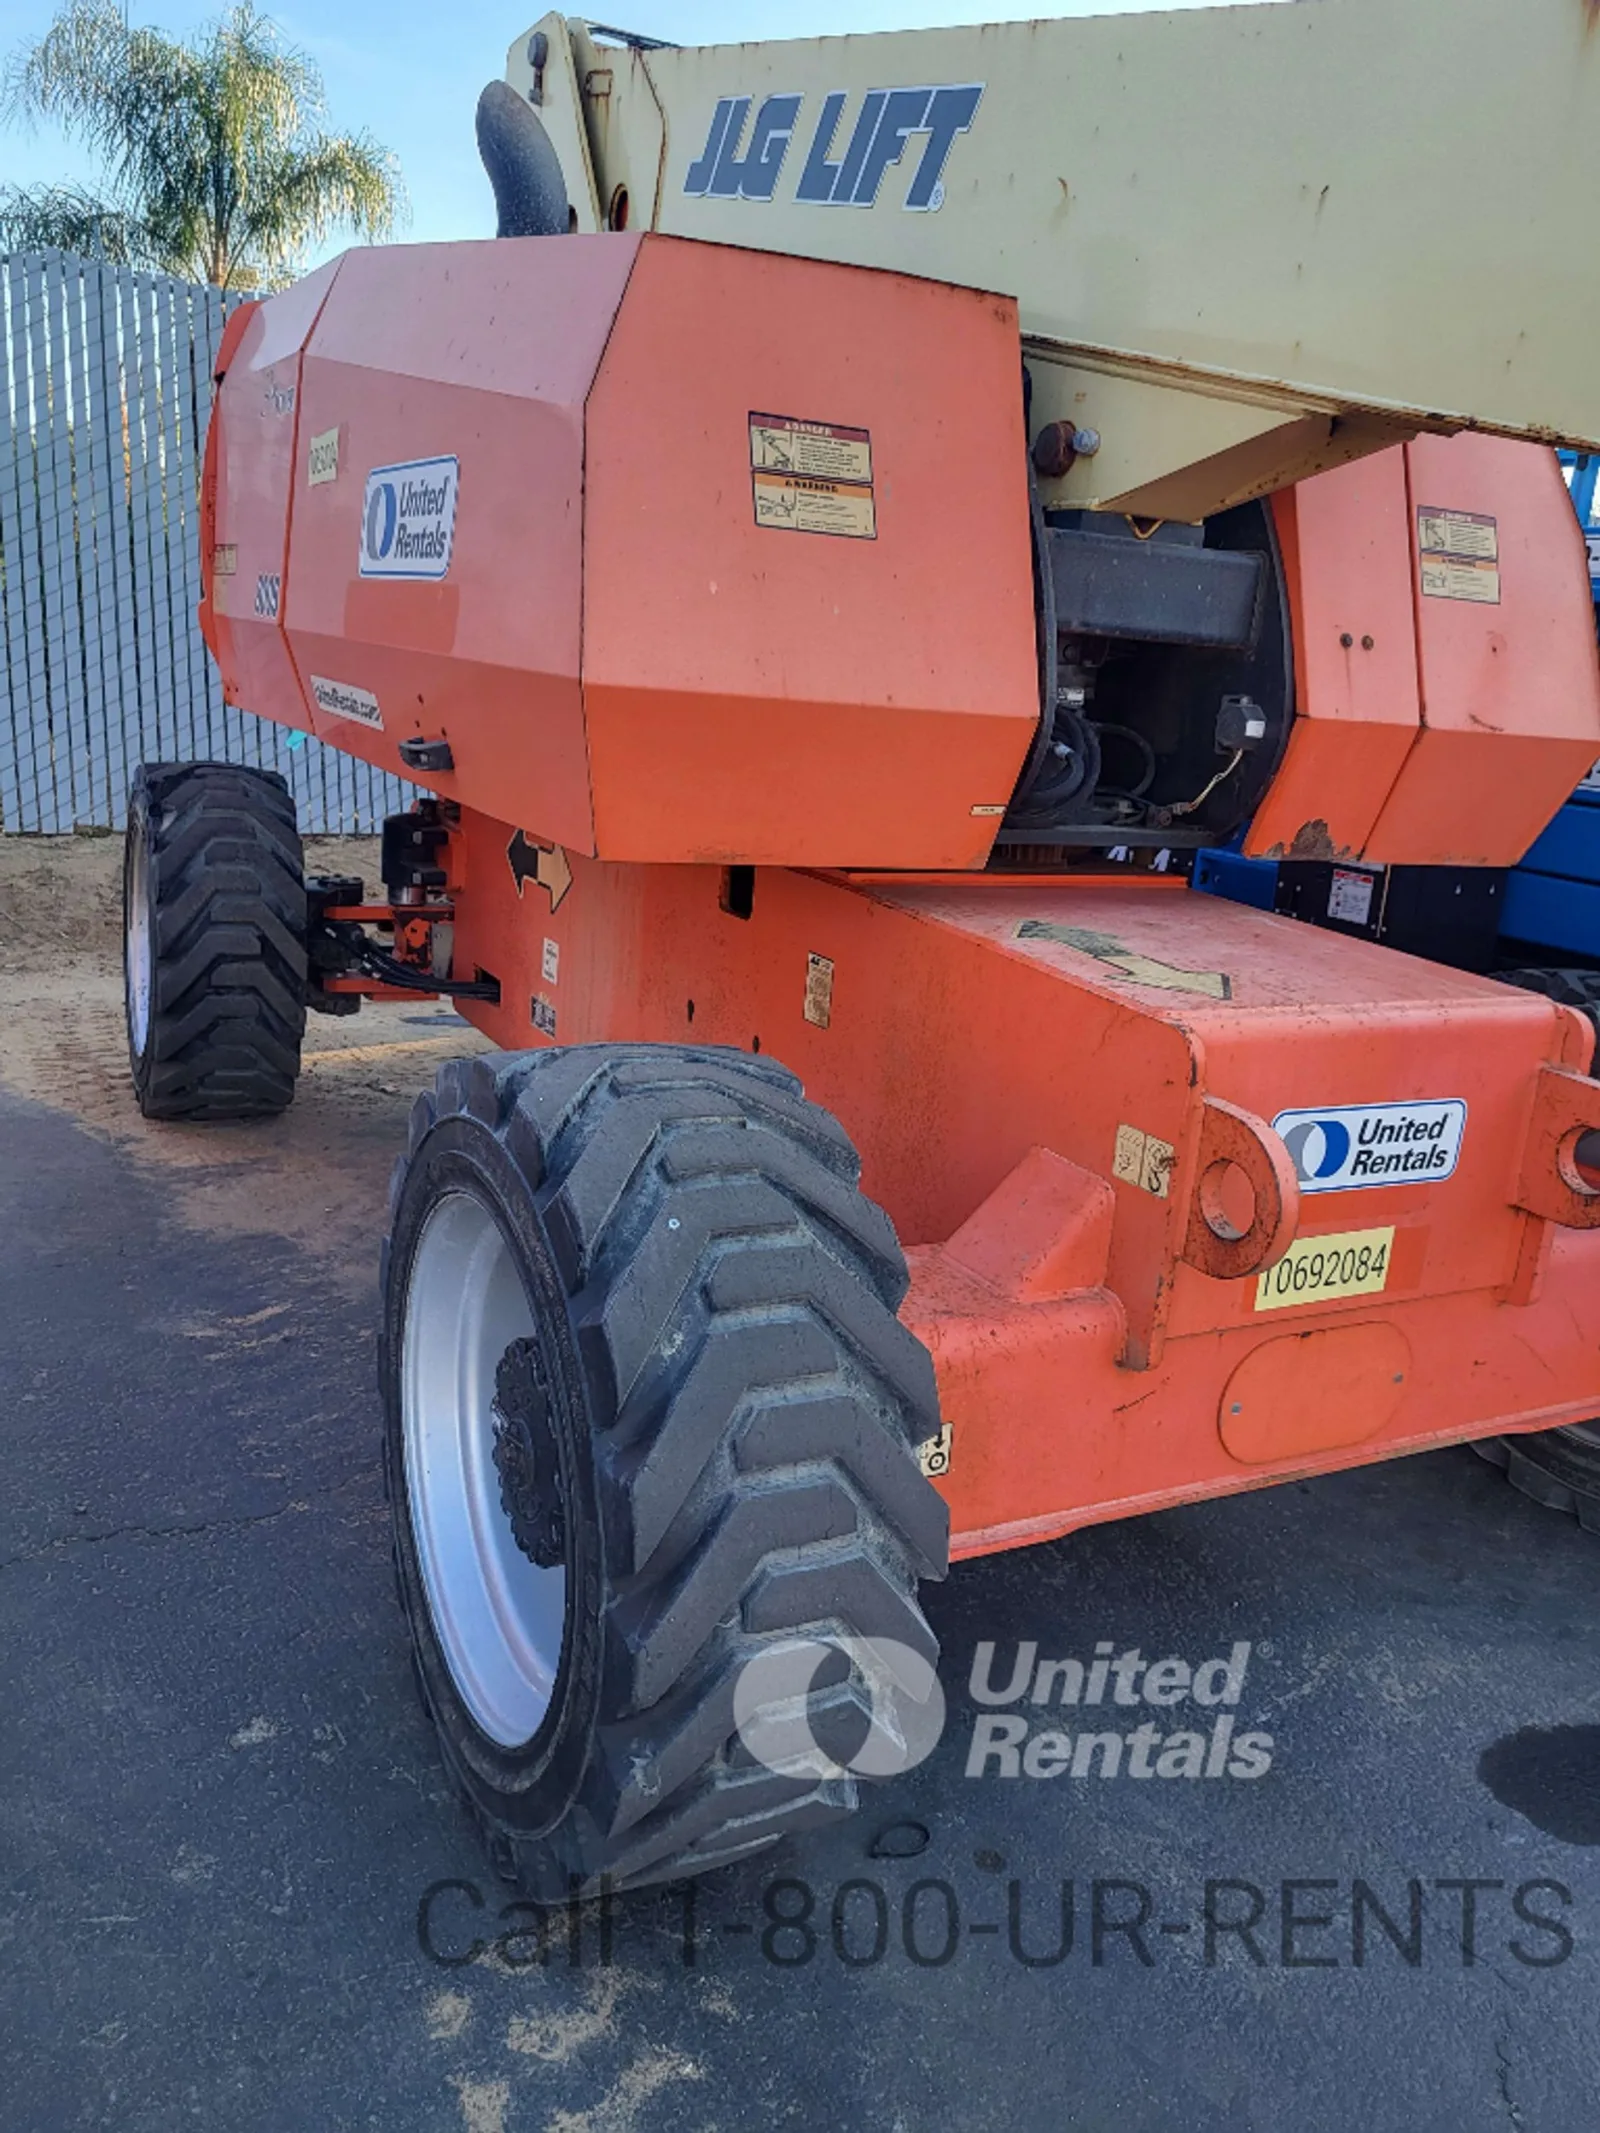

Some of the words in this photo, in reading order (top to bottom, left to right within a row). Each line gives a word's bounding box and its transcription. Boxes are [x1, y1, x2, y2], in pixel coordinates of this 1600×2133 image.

[684, 92, 804, 202] JLG
[792, 82, 986, 212] LIFT
[400, 476, 451, 516] United
[395, 521, 448, 561] Rentals
[1358, 1113, 1448, 1145] United
[1350, 1144, 1447, 1176] Rentals
[1263, 1244, 1387, 1296] 10692084
